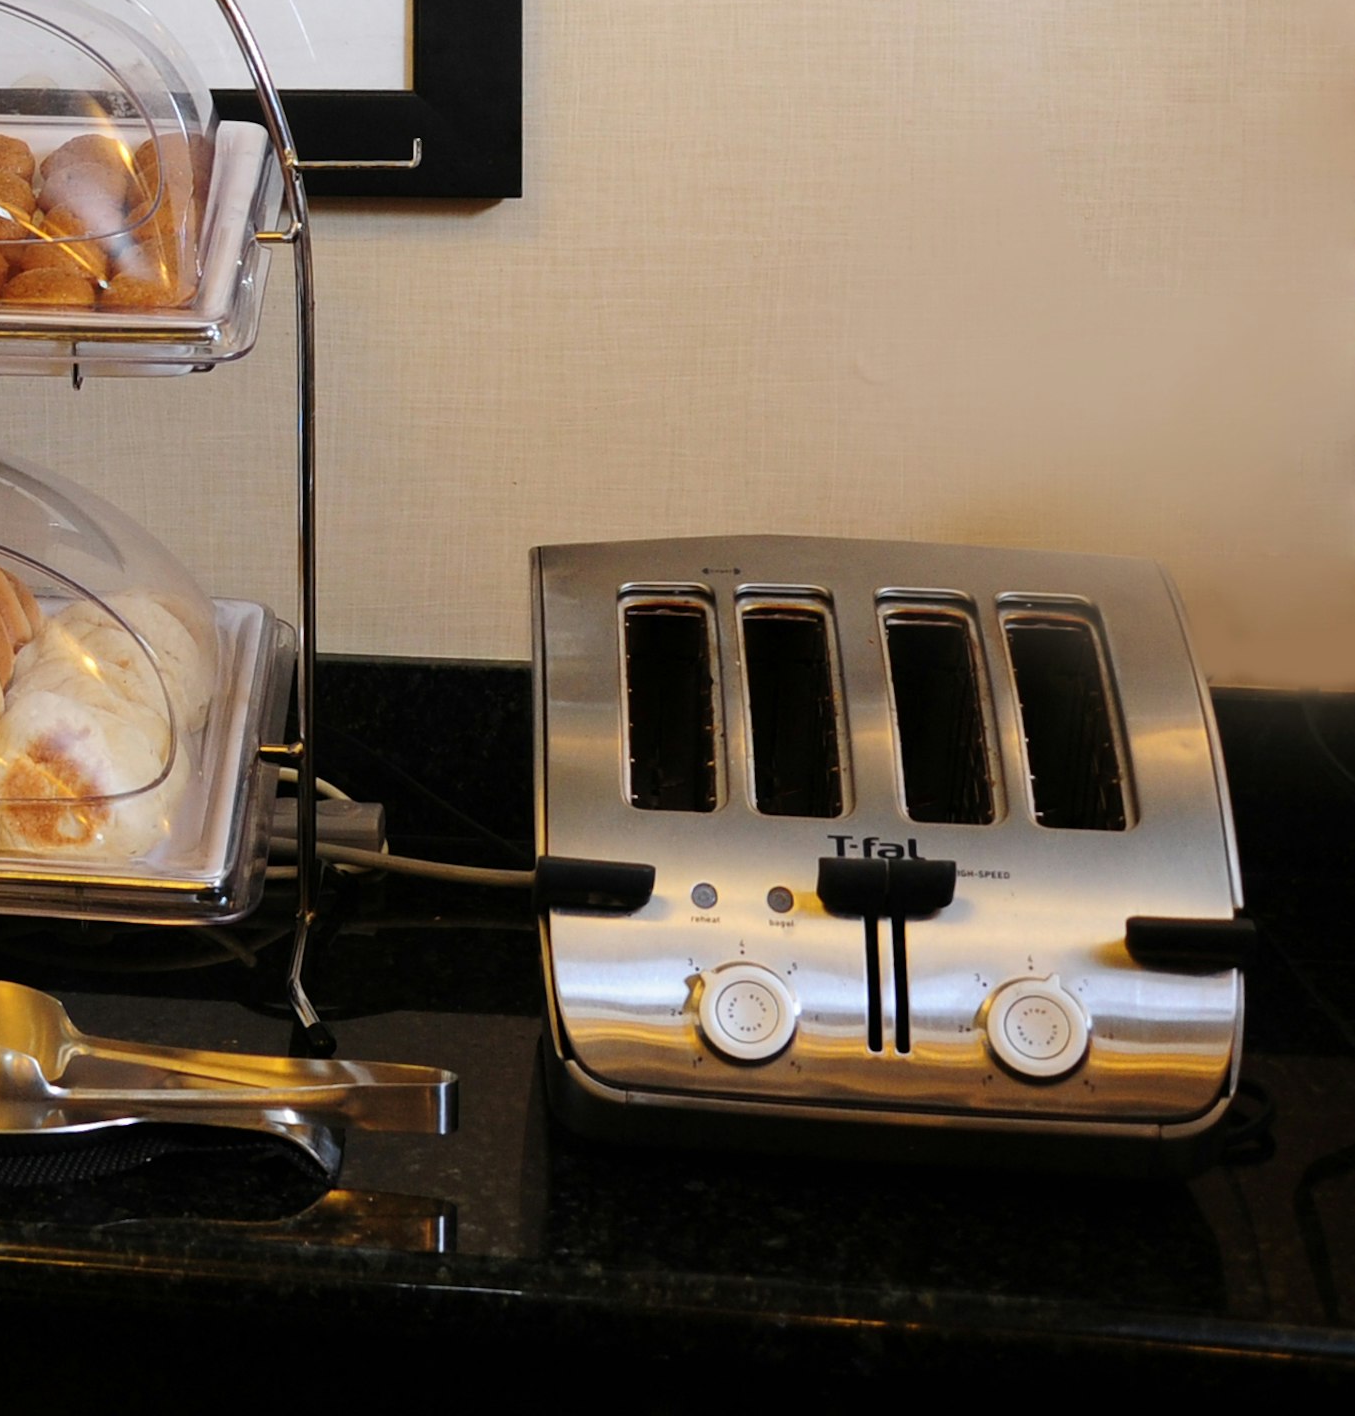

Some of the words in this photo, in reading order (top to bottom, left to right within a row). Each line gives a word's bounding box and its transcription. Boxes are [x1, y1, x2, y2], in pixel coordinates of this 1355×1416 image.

[827, 834, 927, 861] T-fal
[690, 915, 721, 924] reheat
[768, 918, 795, 928] bagel
